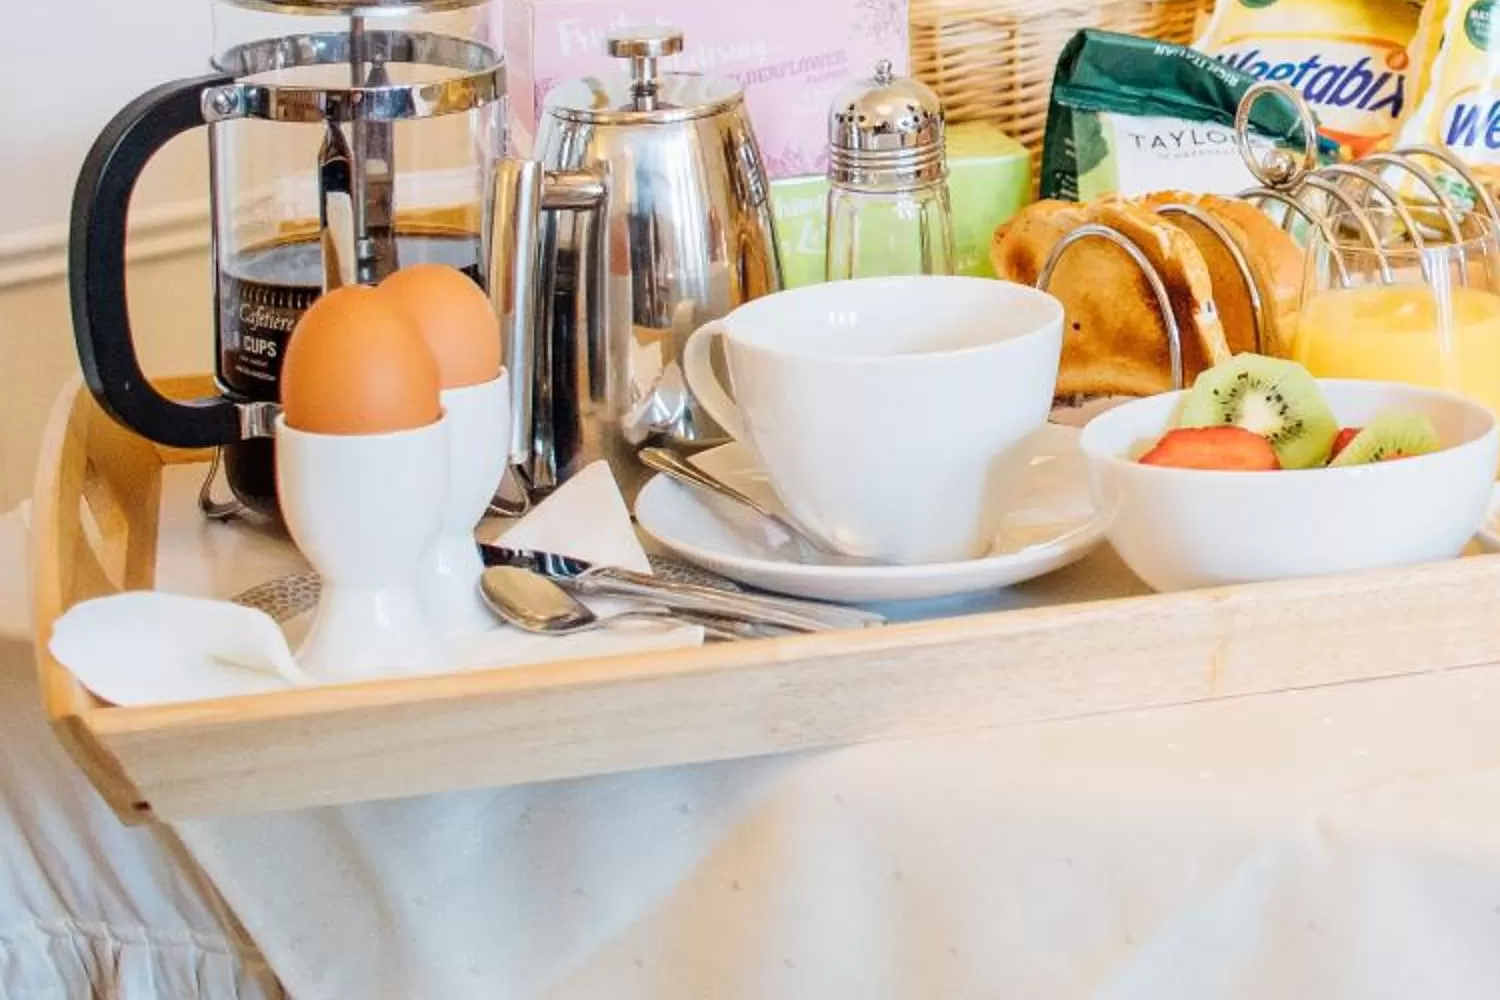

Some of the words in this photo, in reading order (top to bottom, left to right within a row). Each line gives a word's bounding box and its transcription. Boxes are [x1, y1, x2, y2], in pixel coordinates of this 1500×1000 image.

[1206, 62, 1239, 87] RICH
[1128, 128, 1245, 152] TAYLO
[243, 335, 277, 358] CUPS
